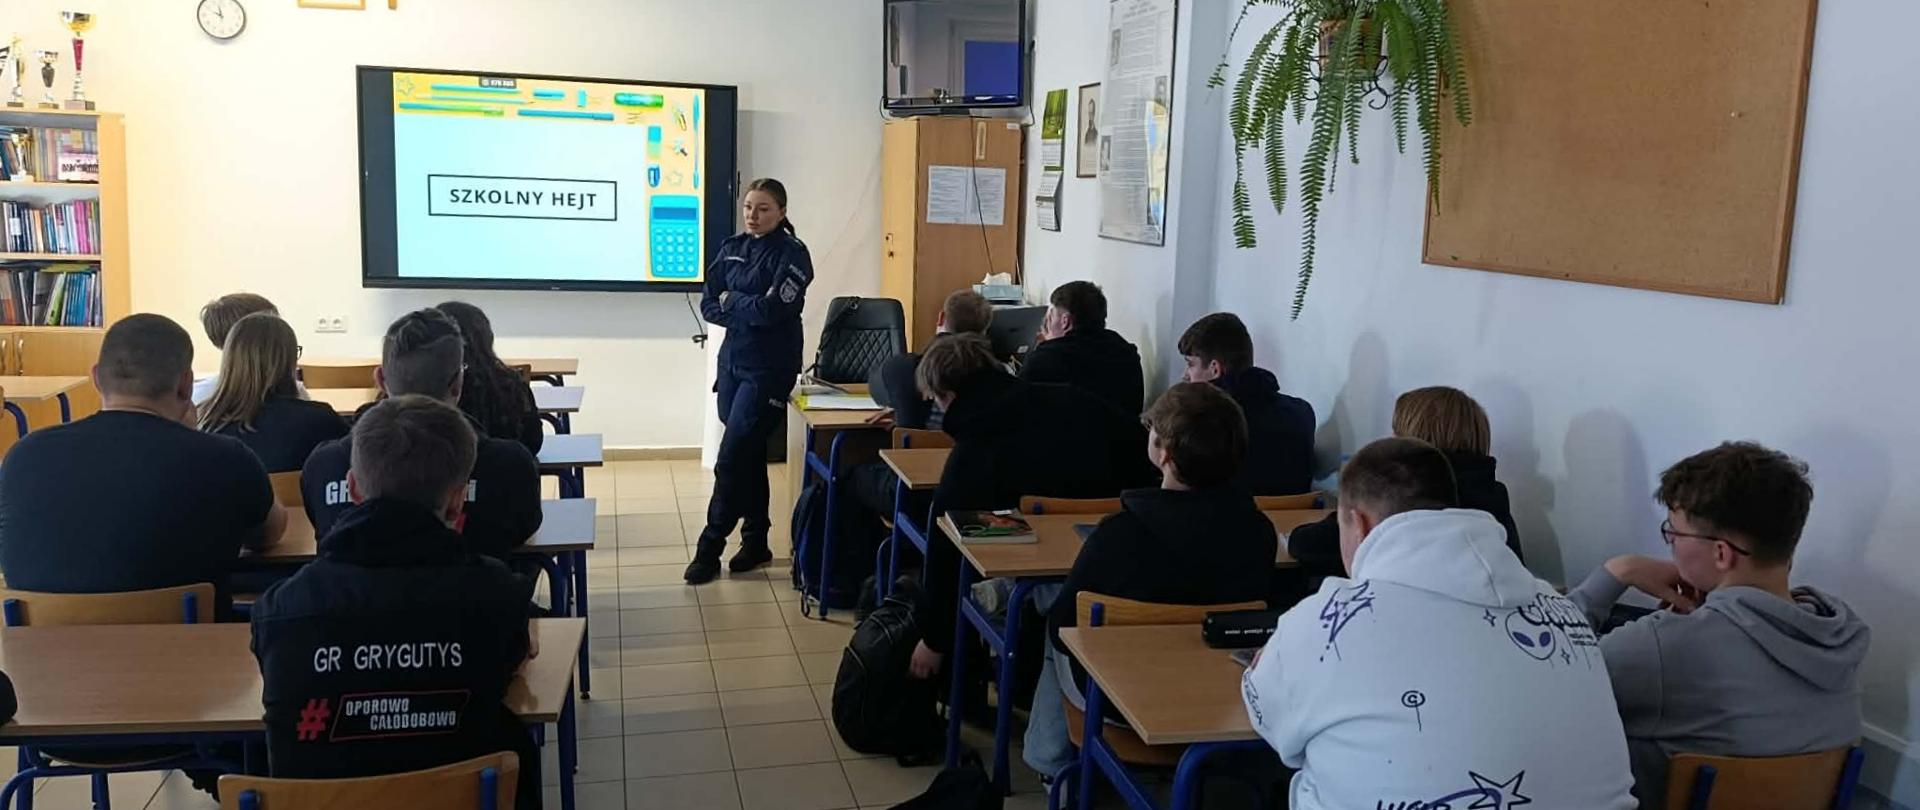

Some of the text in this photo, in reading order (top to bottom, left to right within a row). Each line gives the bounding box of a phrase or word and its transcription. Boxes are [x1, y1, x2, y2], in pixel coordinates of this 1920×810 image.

[449, 188, 597, 211] SZKOLNY HEJT
[313, 642, 463, 672] GR GRYGUTYS
[345, 697, 410, 716] OPOROWO
[370, 711, 456, 731] CAŁODOBOWO
